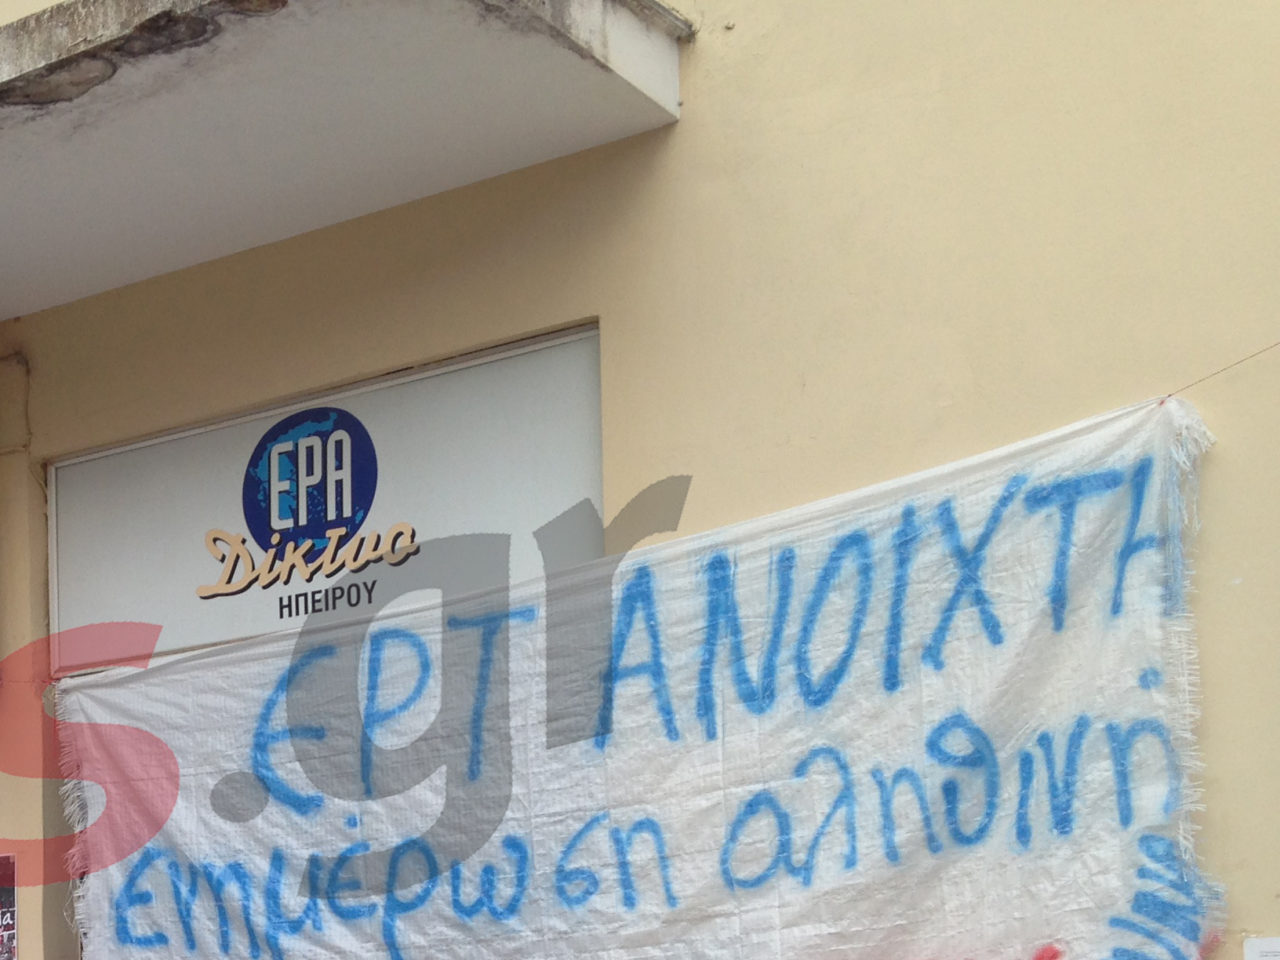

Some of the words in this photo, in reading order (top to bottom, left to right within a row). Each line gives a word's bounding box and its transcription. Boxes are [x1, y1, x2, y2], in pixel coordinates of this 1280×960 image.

[270, 429, 352, 531] ΕΡΑ
[251, 604, 540, 816] ΕΡΤ
[593, 455, 1182, 750] ΑΝΟΙΧΤΗ
[279, 580, 377, 619] ΗΠΕΙΡΟΥ
